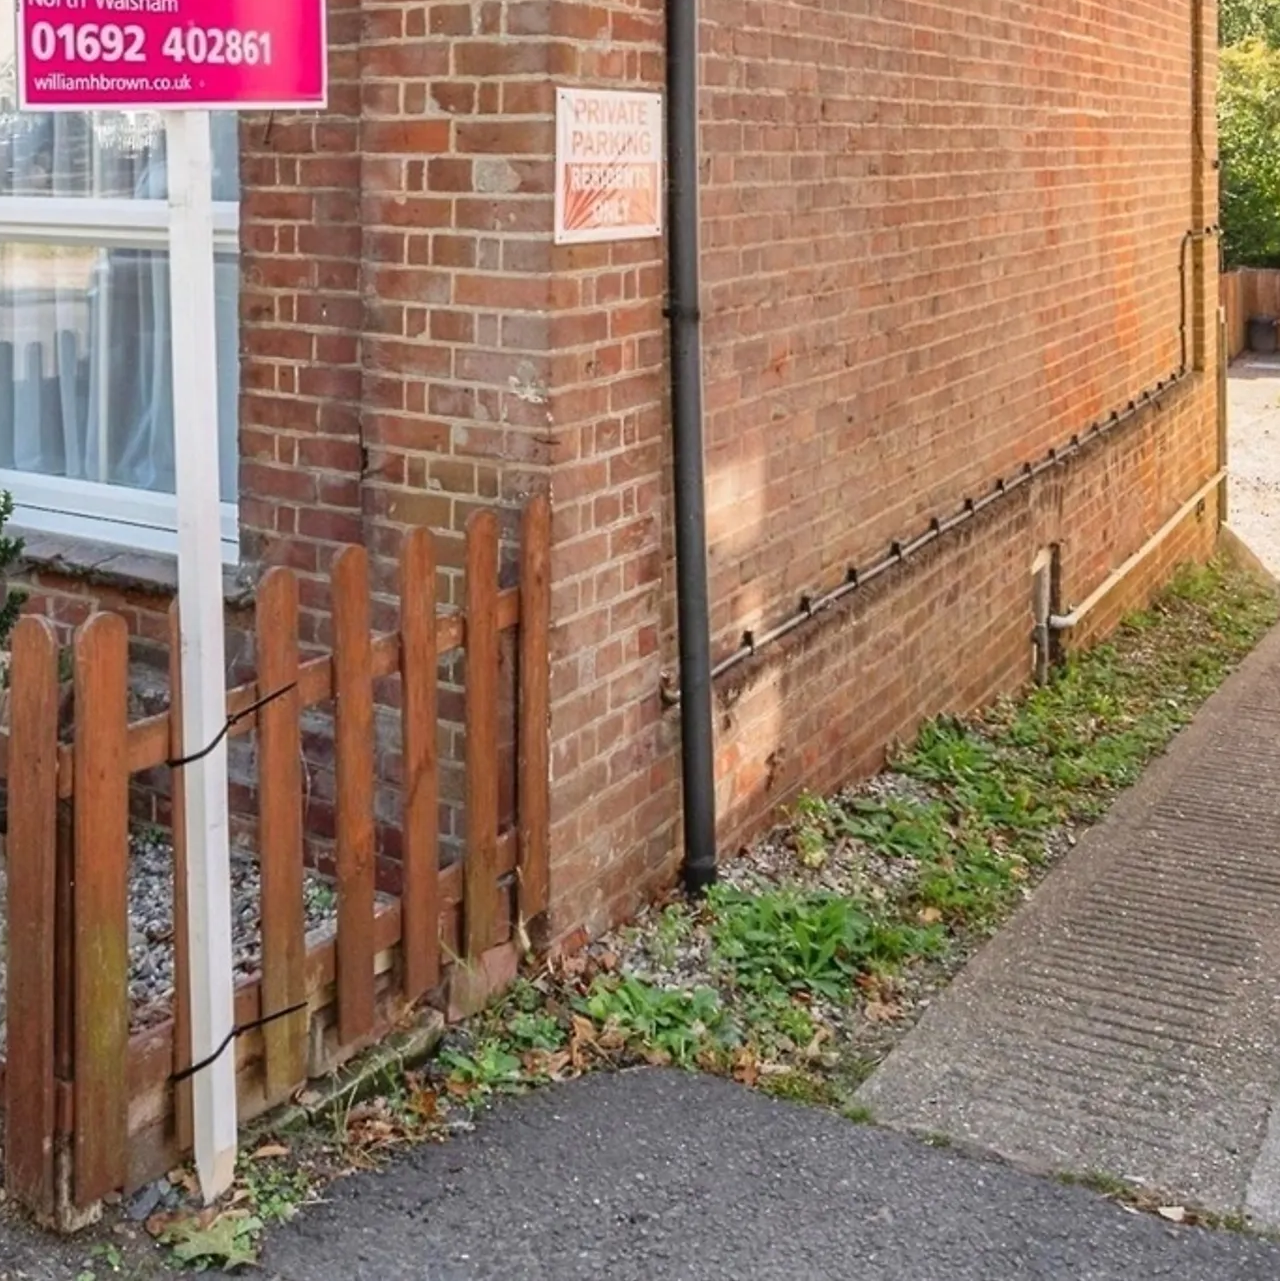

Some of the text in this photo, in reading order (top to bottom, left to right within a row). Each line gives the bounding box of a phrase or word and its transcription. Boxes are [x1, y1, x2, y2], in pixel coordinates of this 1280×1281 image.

[31, 21, 272, 65] 01692 402861
[34, 74, 193, 92] williamhbrown.co.uk
[573, 97, 649, 126] PRIVATE
[571, 129, 652, 158] PARKING
